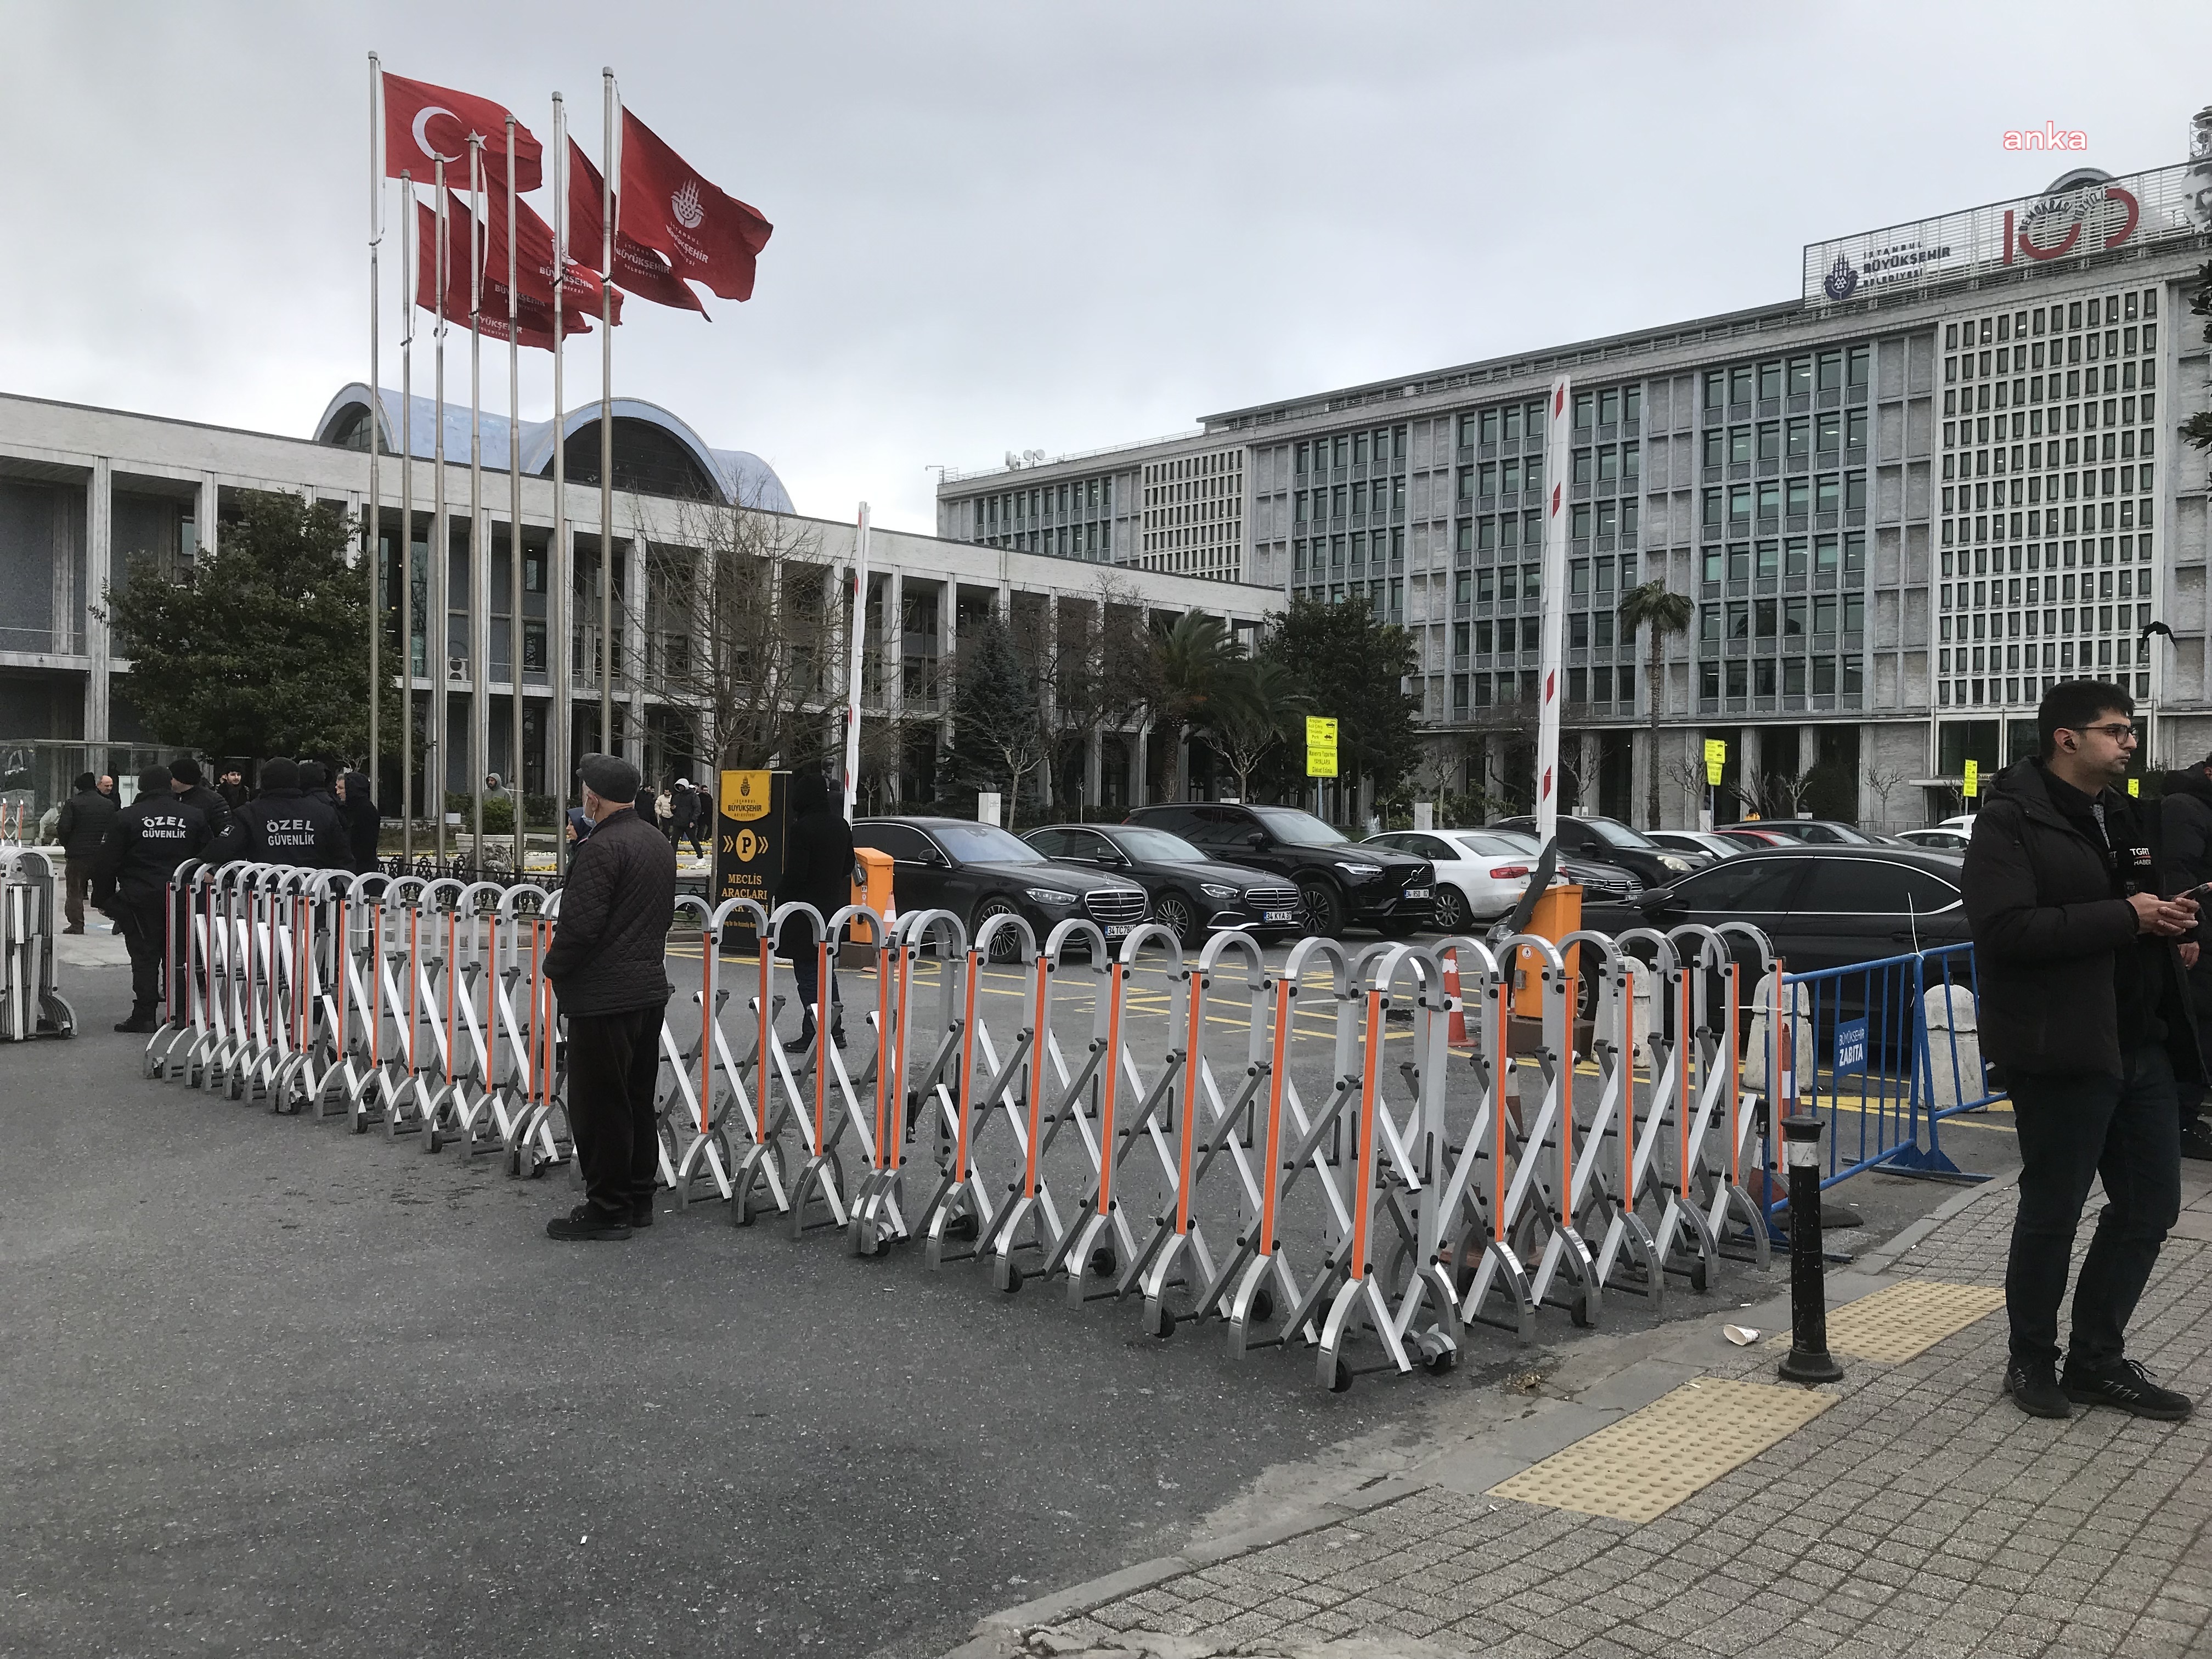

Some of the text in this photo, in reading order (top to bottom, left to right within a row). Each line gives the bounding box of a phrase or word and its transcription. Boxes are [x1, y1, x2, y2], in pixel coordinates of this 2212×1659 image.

[616, 247, 670, 274] BÜYÜKŞEHİR
[727, 803, 762, 813] BÜYÜKŞEHİR
[141, 816, 187, 828] ÖZEL
[267, 820, 314, 833] ÖZEL
[142, 828, 186, 838] GÜVENLİK
[268, 832, 314, 845] GÜVENLİK
[742, 837, 752, 854] P
[2129, 848, 2150, 856] TGRT
[728, 873, 762, 885] MECLİS
[1108, 926, 1115, 935] 34
[1839, 1043, 1863, 1066] ZABITA
